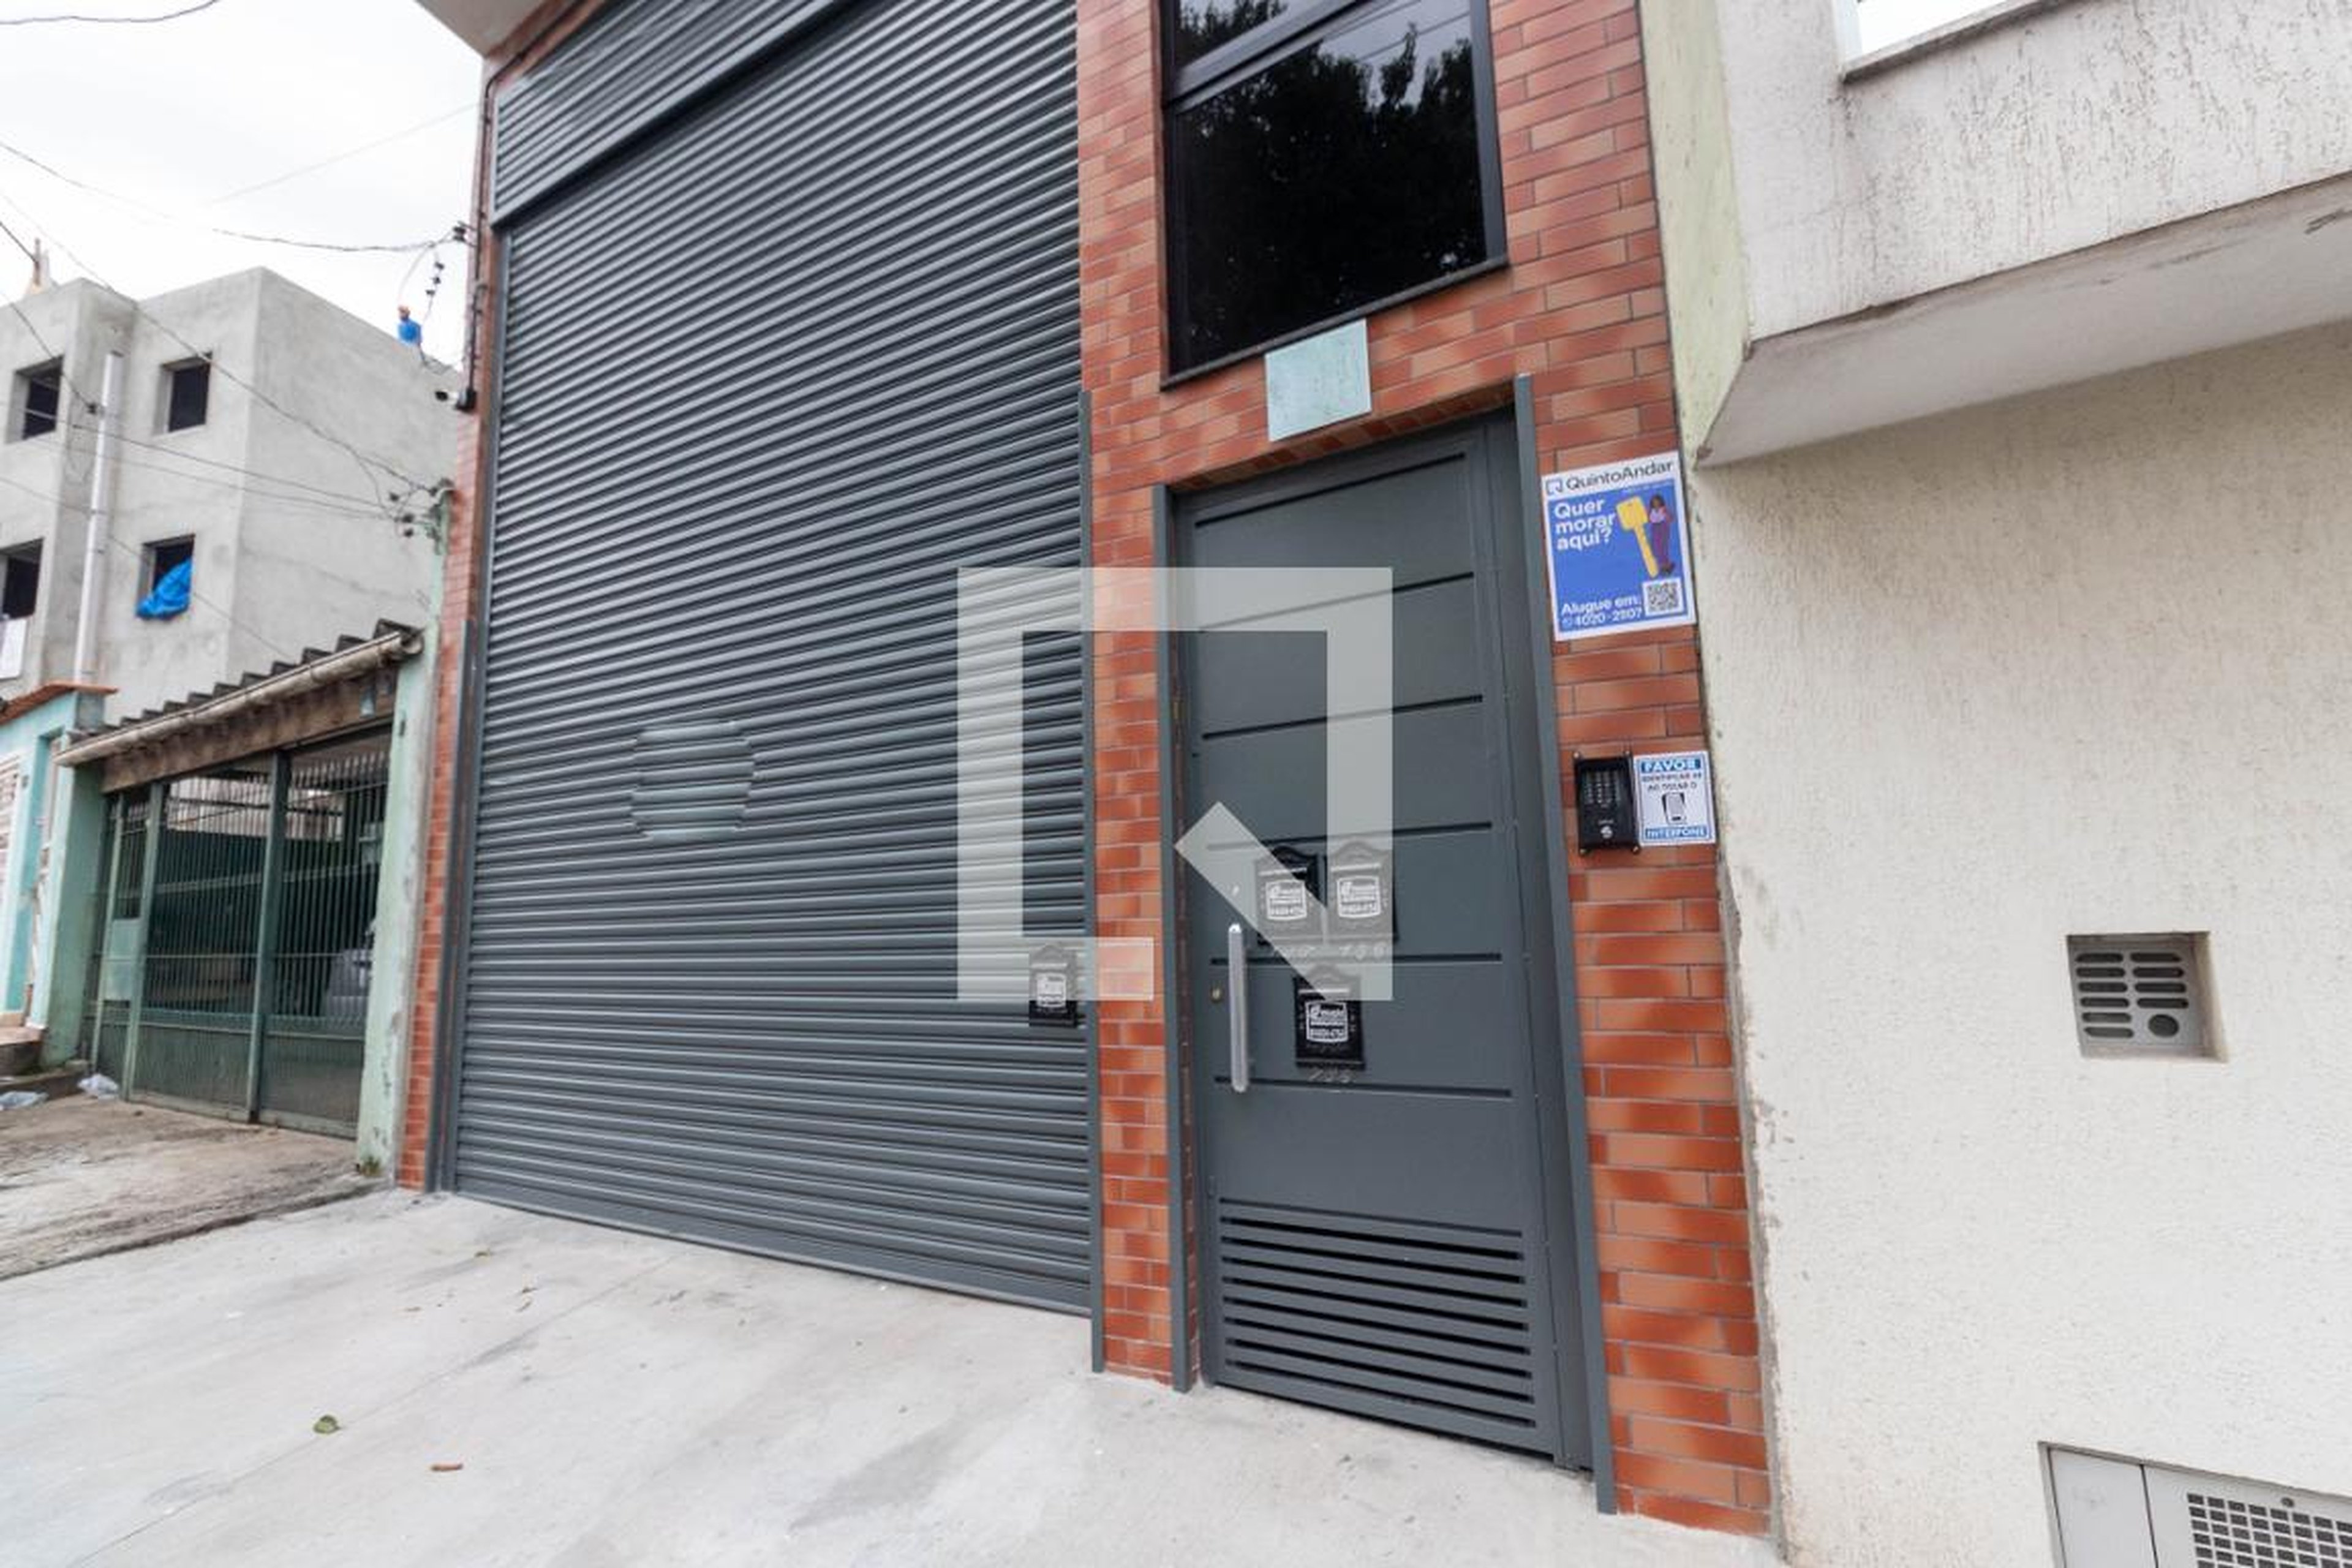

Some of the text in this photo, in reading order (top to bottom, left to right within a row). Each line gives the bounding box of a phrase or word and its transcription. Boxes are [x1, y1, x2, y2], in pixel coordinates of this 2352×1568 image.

[1566, 461, 1673, 490] QuintoAndar
[1555, 499, 1604, 519] Quer
[1555, 512, 1616, 535] morar
[1556, 527, 1613, 552] aqui?
[1562, 598, 1612, 616] Alugue
[1643, 759, 1695, 772] FAVOR
